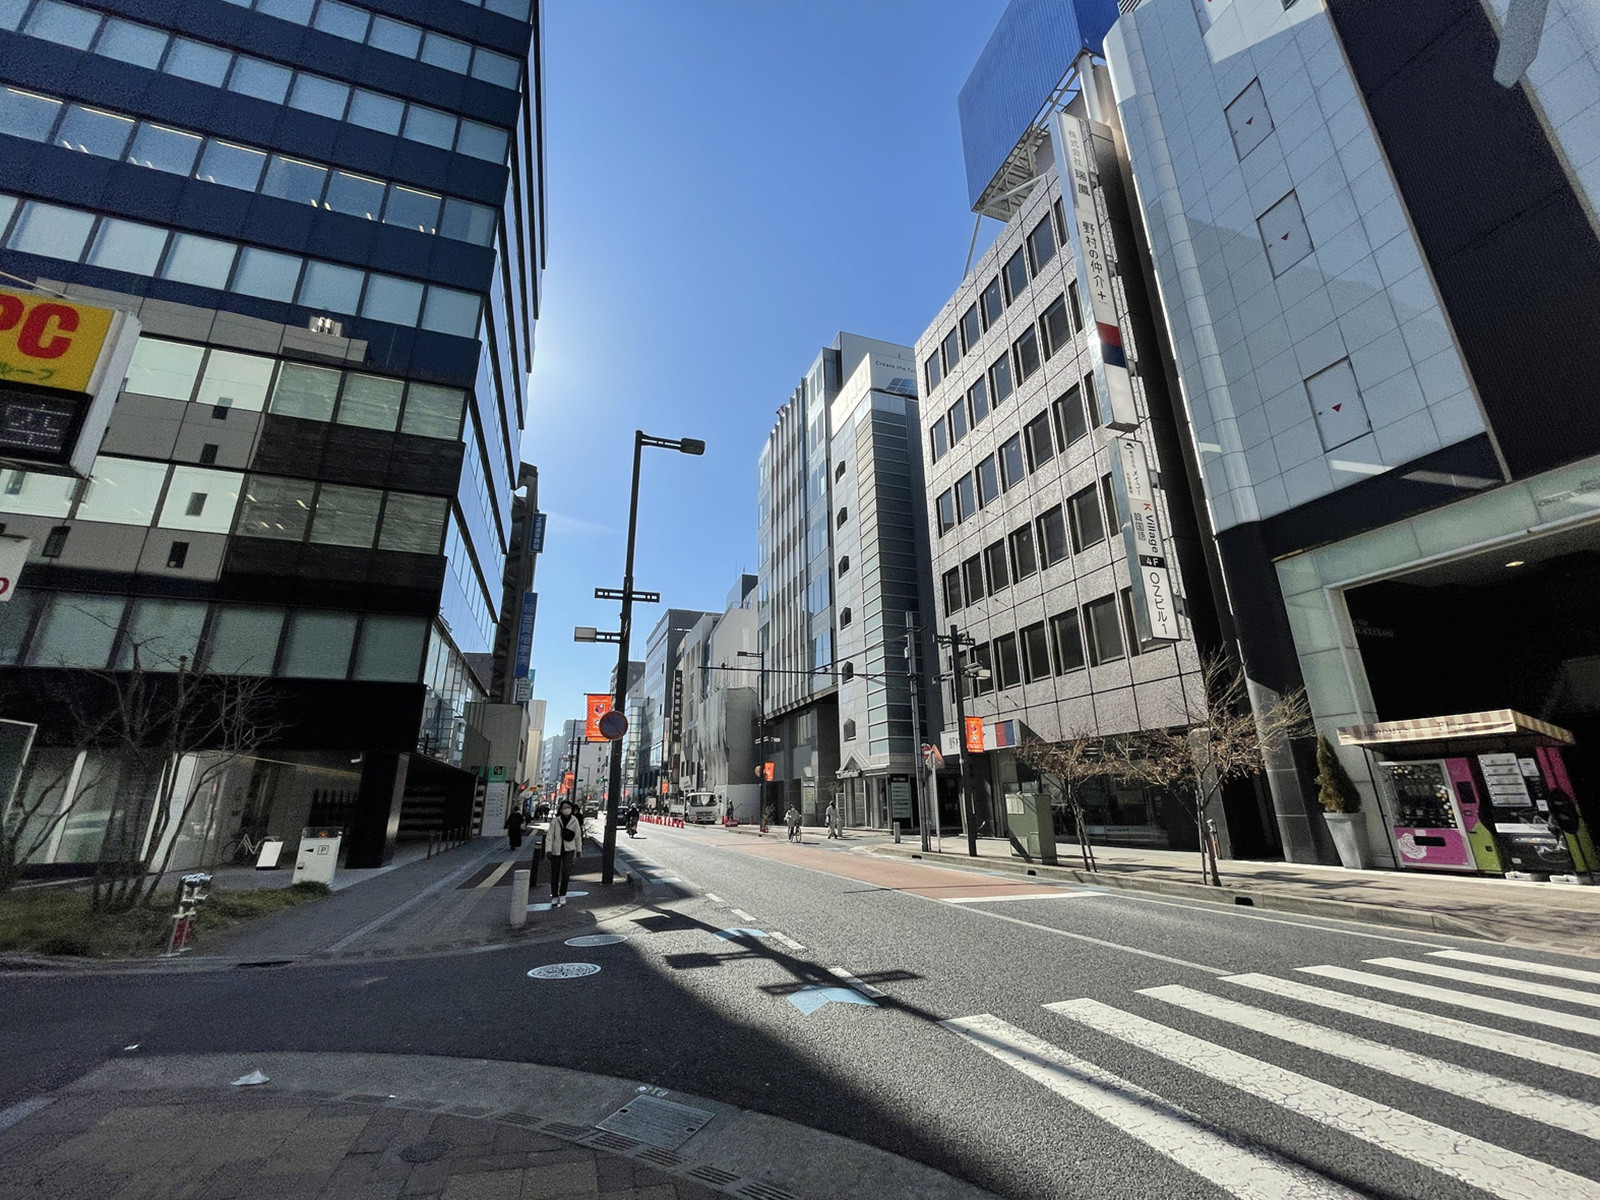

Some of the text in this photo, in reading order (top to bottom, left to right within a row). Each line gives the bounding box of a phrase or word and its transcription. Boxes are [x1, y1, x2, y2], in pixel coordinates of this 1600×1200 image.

[1143, 502, 1159, 554] K Village
[1146, 557, 1159, 567] 4F
